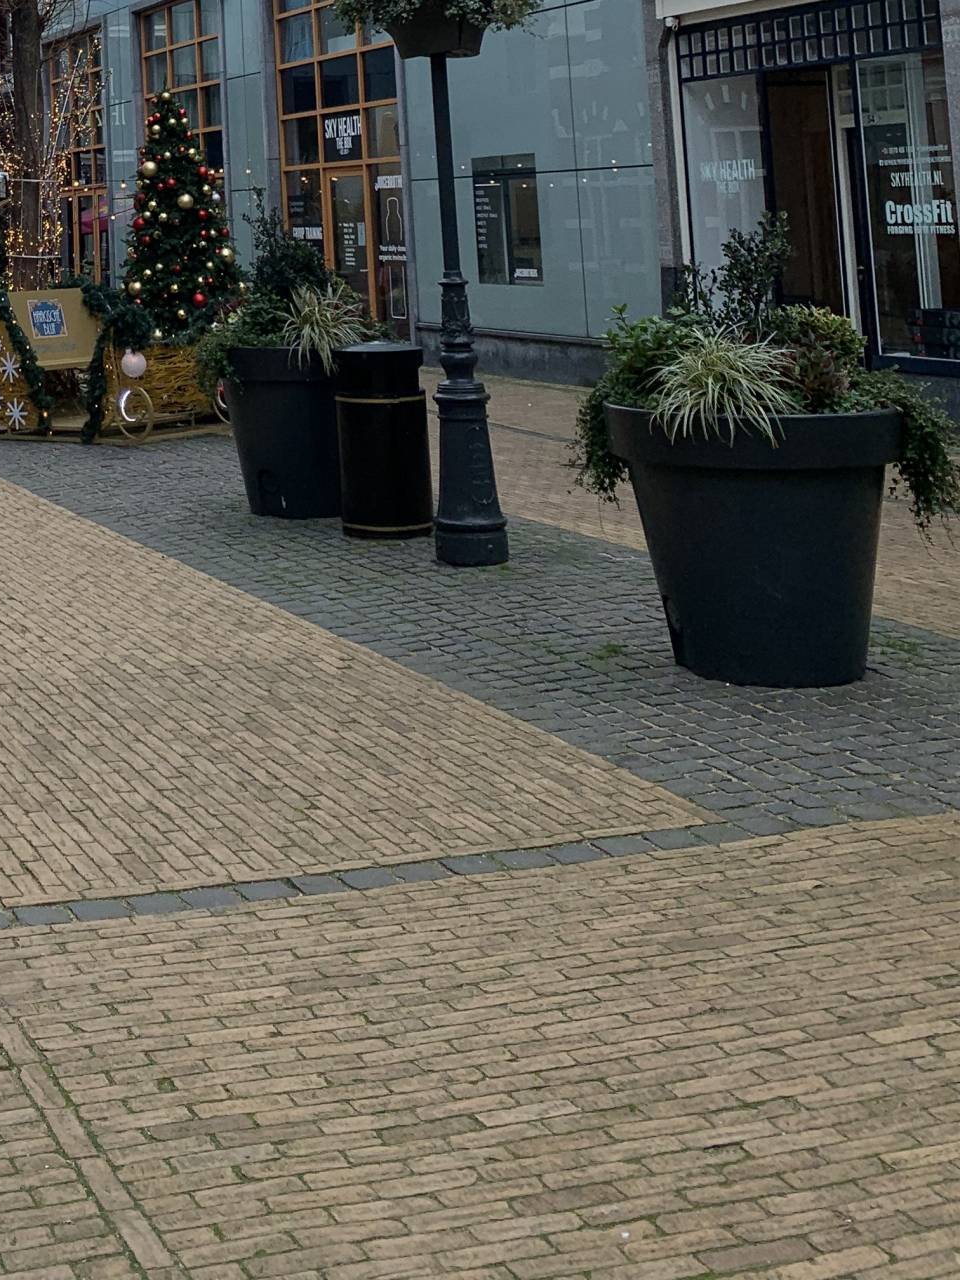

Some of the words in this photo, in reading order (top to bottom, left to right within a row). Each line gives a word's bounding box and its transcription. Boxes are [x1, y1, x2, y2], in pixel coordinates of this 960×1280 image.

[325, 118, 337, 138] SKY
[338, 116, 361, 136] HEALTH
[336, 137, 344, 149] THE
[720, 159, 755, 180] HEALTH
[885, 200, 953, 224] CrossFit
